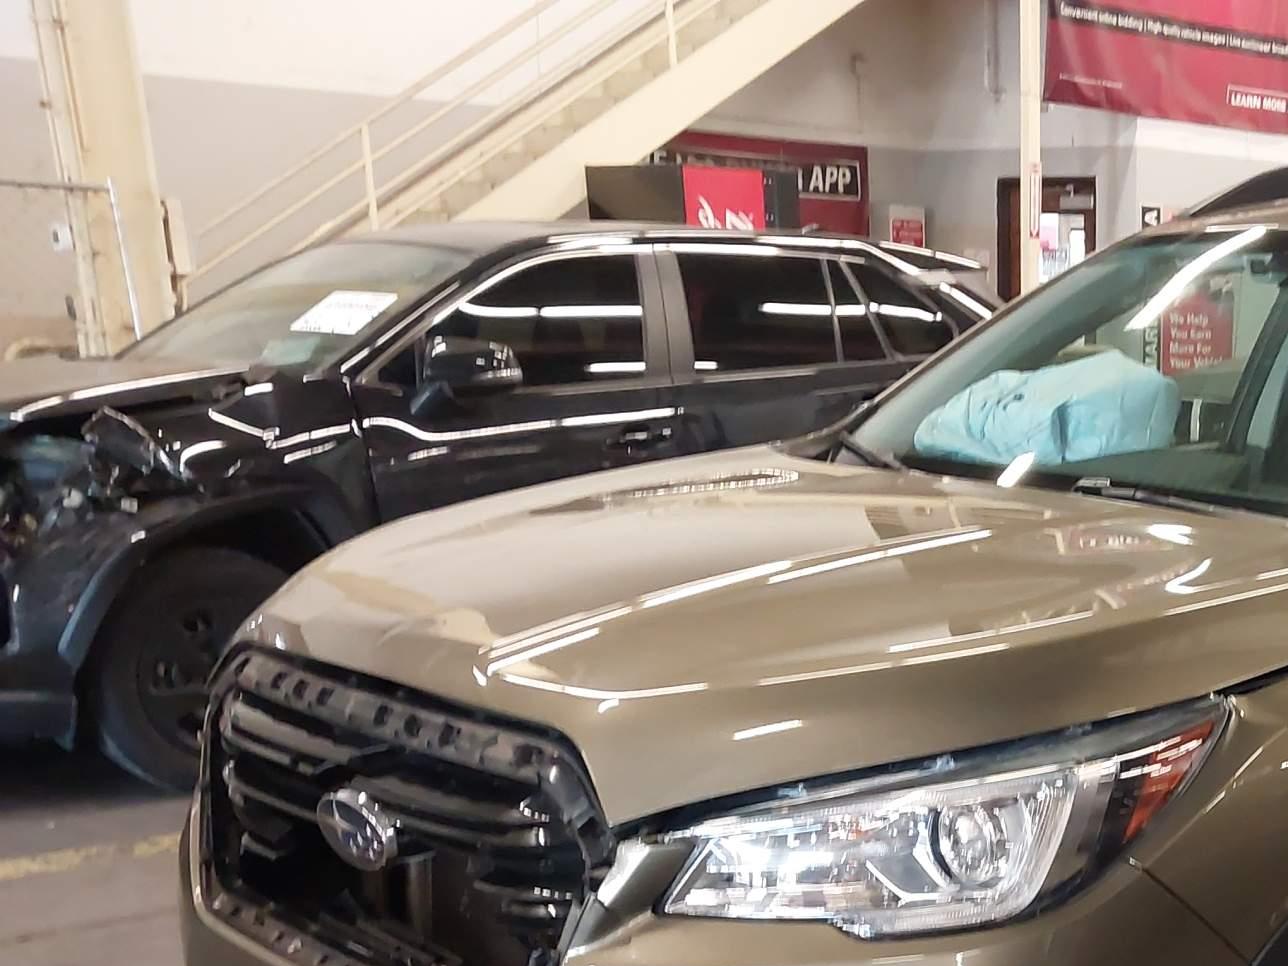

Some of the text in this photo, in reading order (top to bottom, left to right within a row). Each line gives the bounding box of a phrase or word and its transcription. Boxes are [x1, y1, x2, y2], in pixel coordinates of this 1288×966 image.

[1118, 13, 1143, 32] bidding
[1231, 92, 1261, 109] LEARN
[1263, 96, 1286, 113] MORE
[809, 165, 851, 193] APP
[1187, 312, 1209, 328] Help
[1170, 328, 1212, 339] You Earn
[1169, 341, 1212, 354] More For
[1170, 356, 1191, 369] Your
